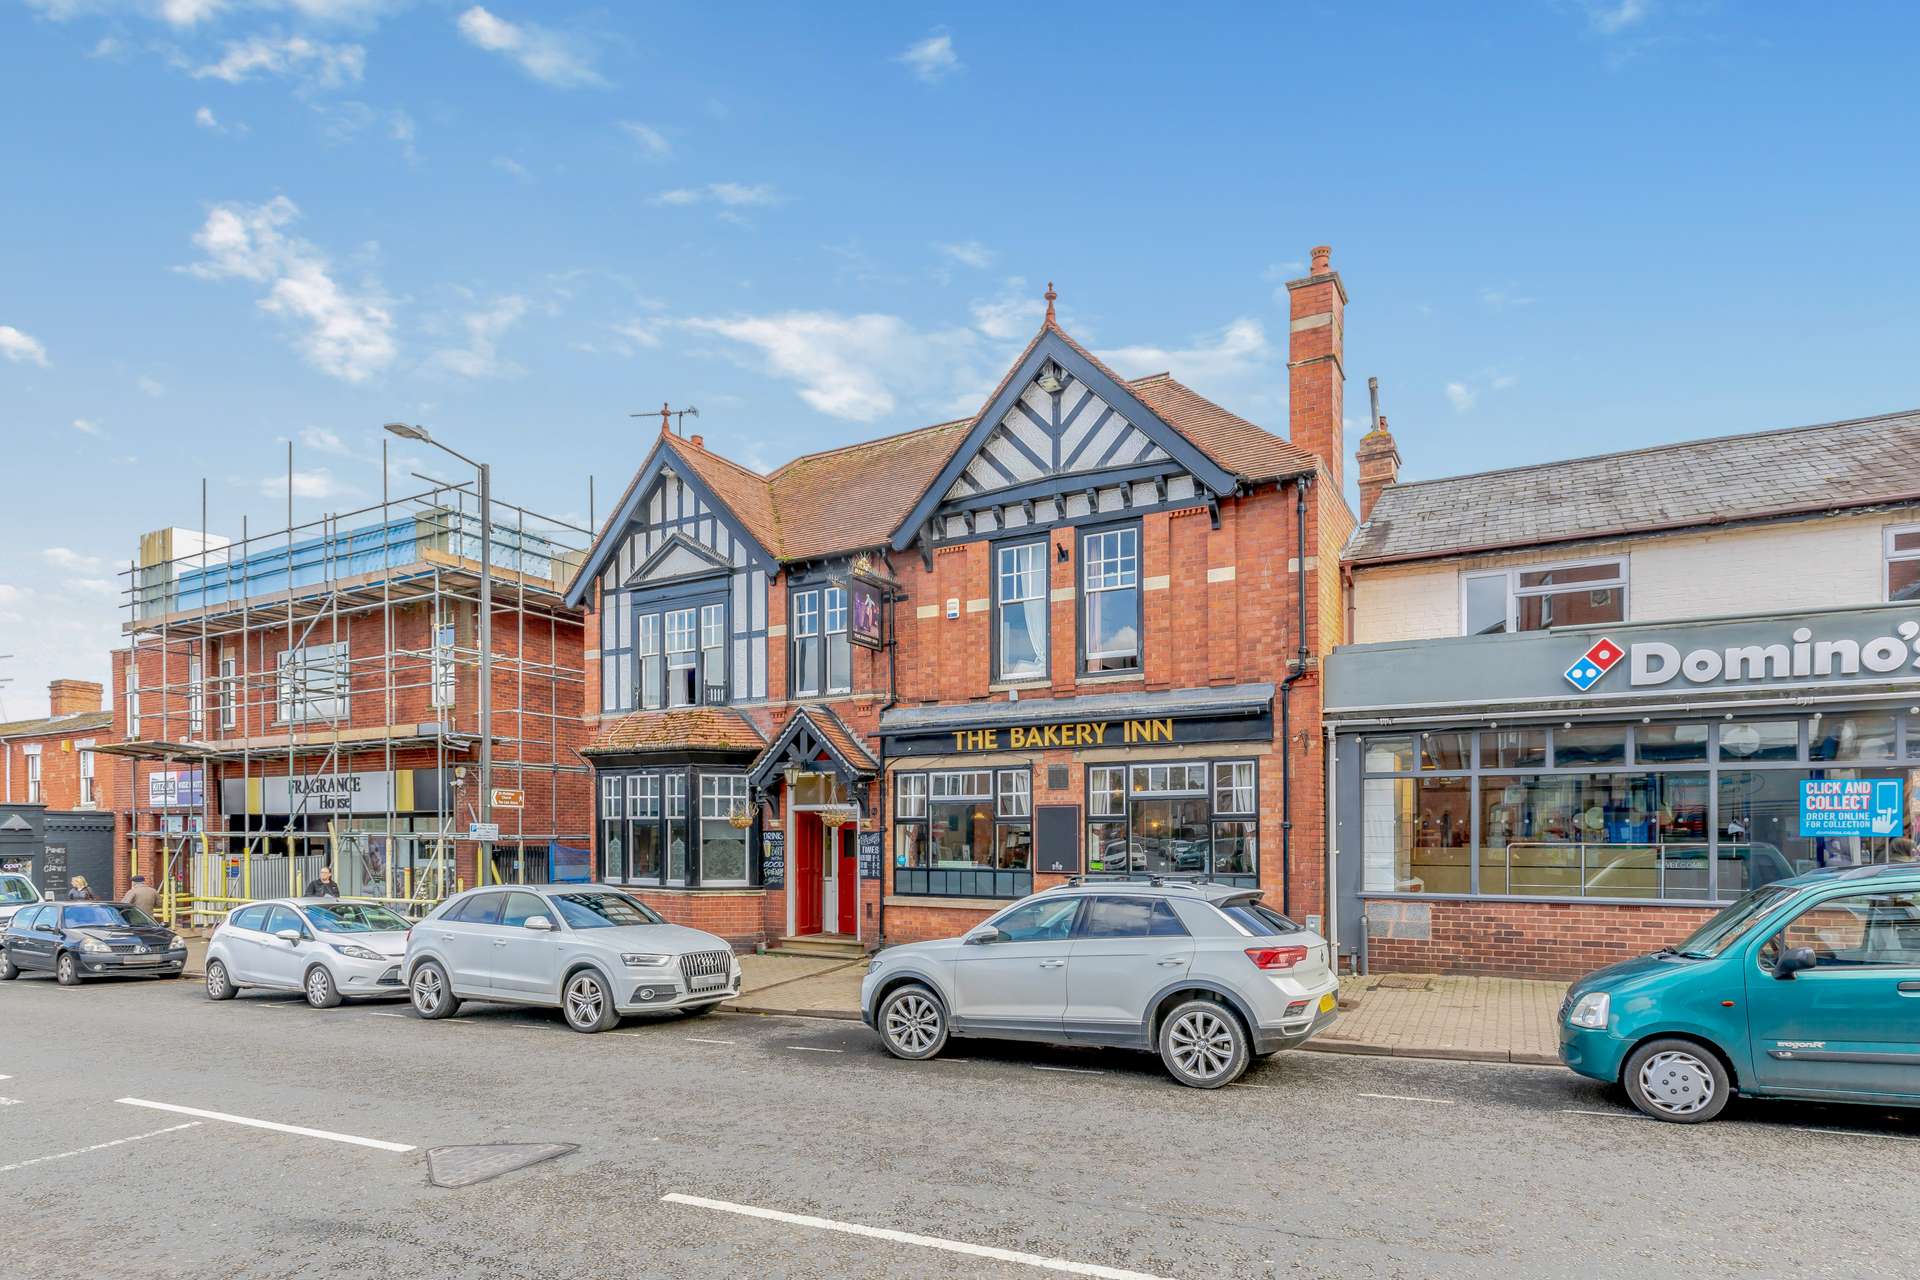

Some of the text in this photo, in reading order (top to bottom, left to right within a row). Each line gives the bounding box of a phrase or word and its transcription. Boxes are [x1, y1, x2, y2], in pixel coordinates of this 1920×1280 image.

[1631, 621, 1920, 686] Domino'
[952, 718, 1174, 751] THE BAKERY INN
[288, 777, 361, 794] FRAGRANCE
[1806, 782, 1871, 794] CLICK AND
[1806, 795, 1871, 810] COLLECT
[1806, 812, 1870, 820] ORDER ONLINE
[1823, 820, 1870, 828] COLLECTION
